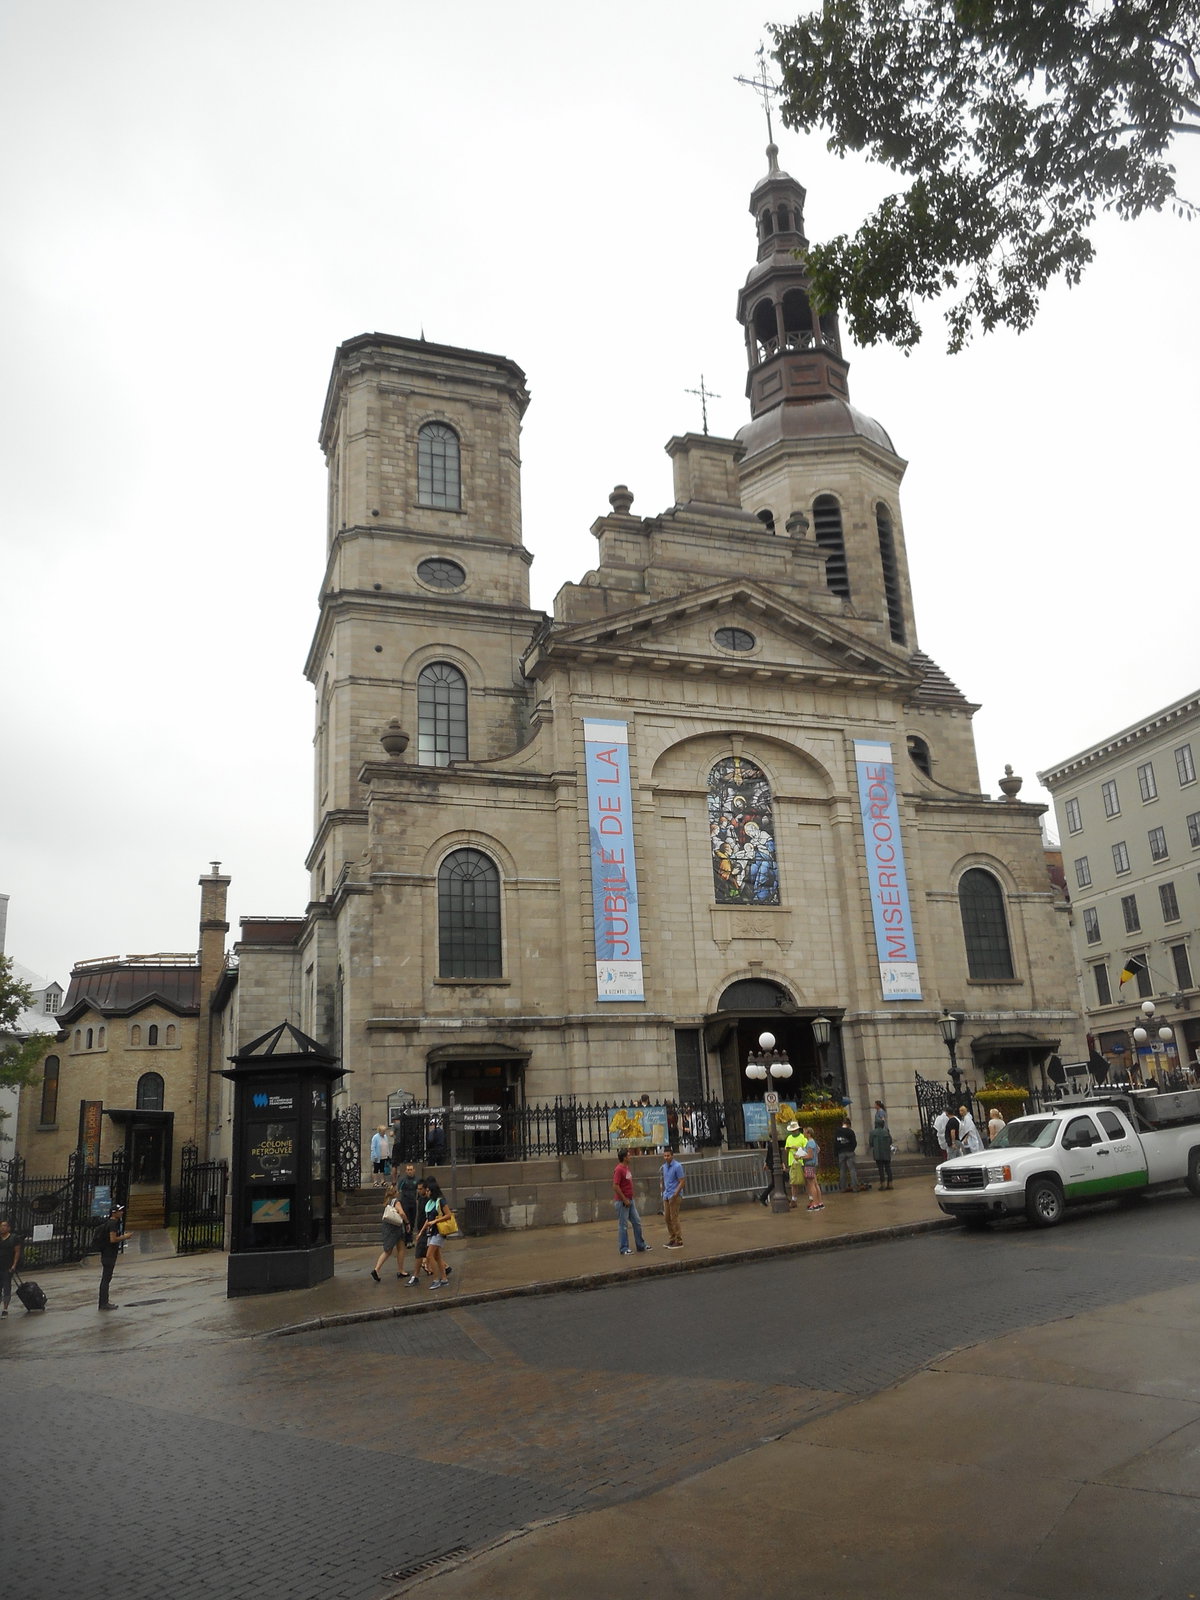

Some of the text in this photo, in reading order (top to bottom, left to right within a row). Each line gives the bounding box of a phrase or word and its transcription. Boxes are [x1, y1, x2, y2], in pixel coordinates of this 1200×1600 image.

[596, 748, 620, 784] LA
[598, 796, 623, 835] DE
[866, 766, 908, 960] MISÉRICORDE
[597, 847, 630, 956] JUBILÉ
[260, 1140, 293, 1149] COLONIE
